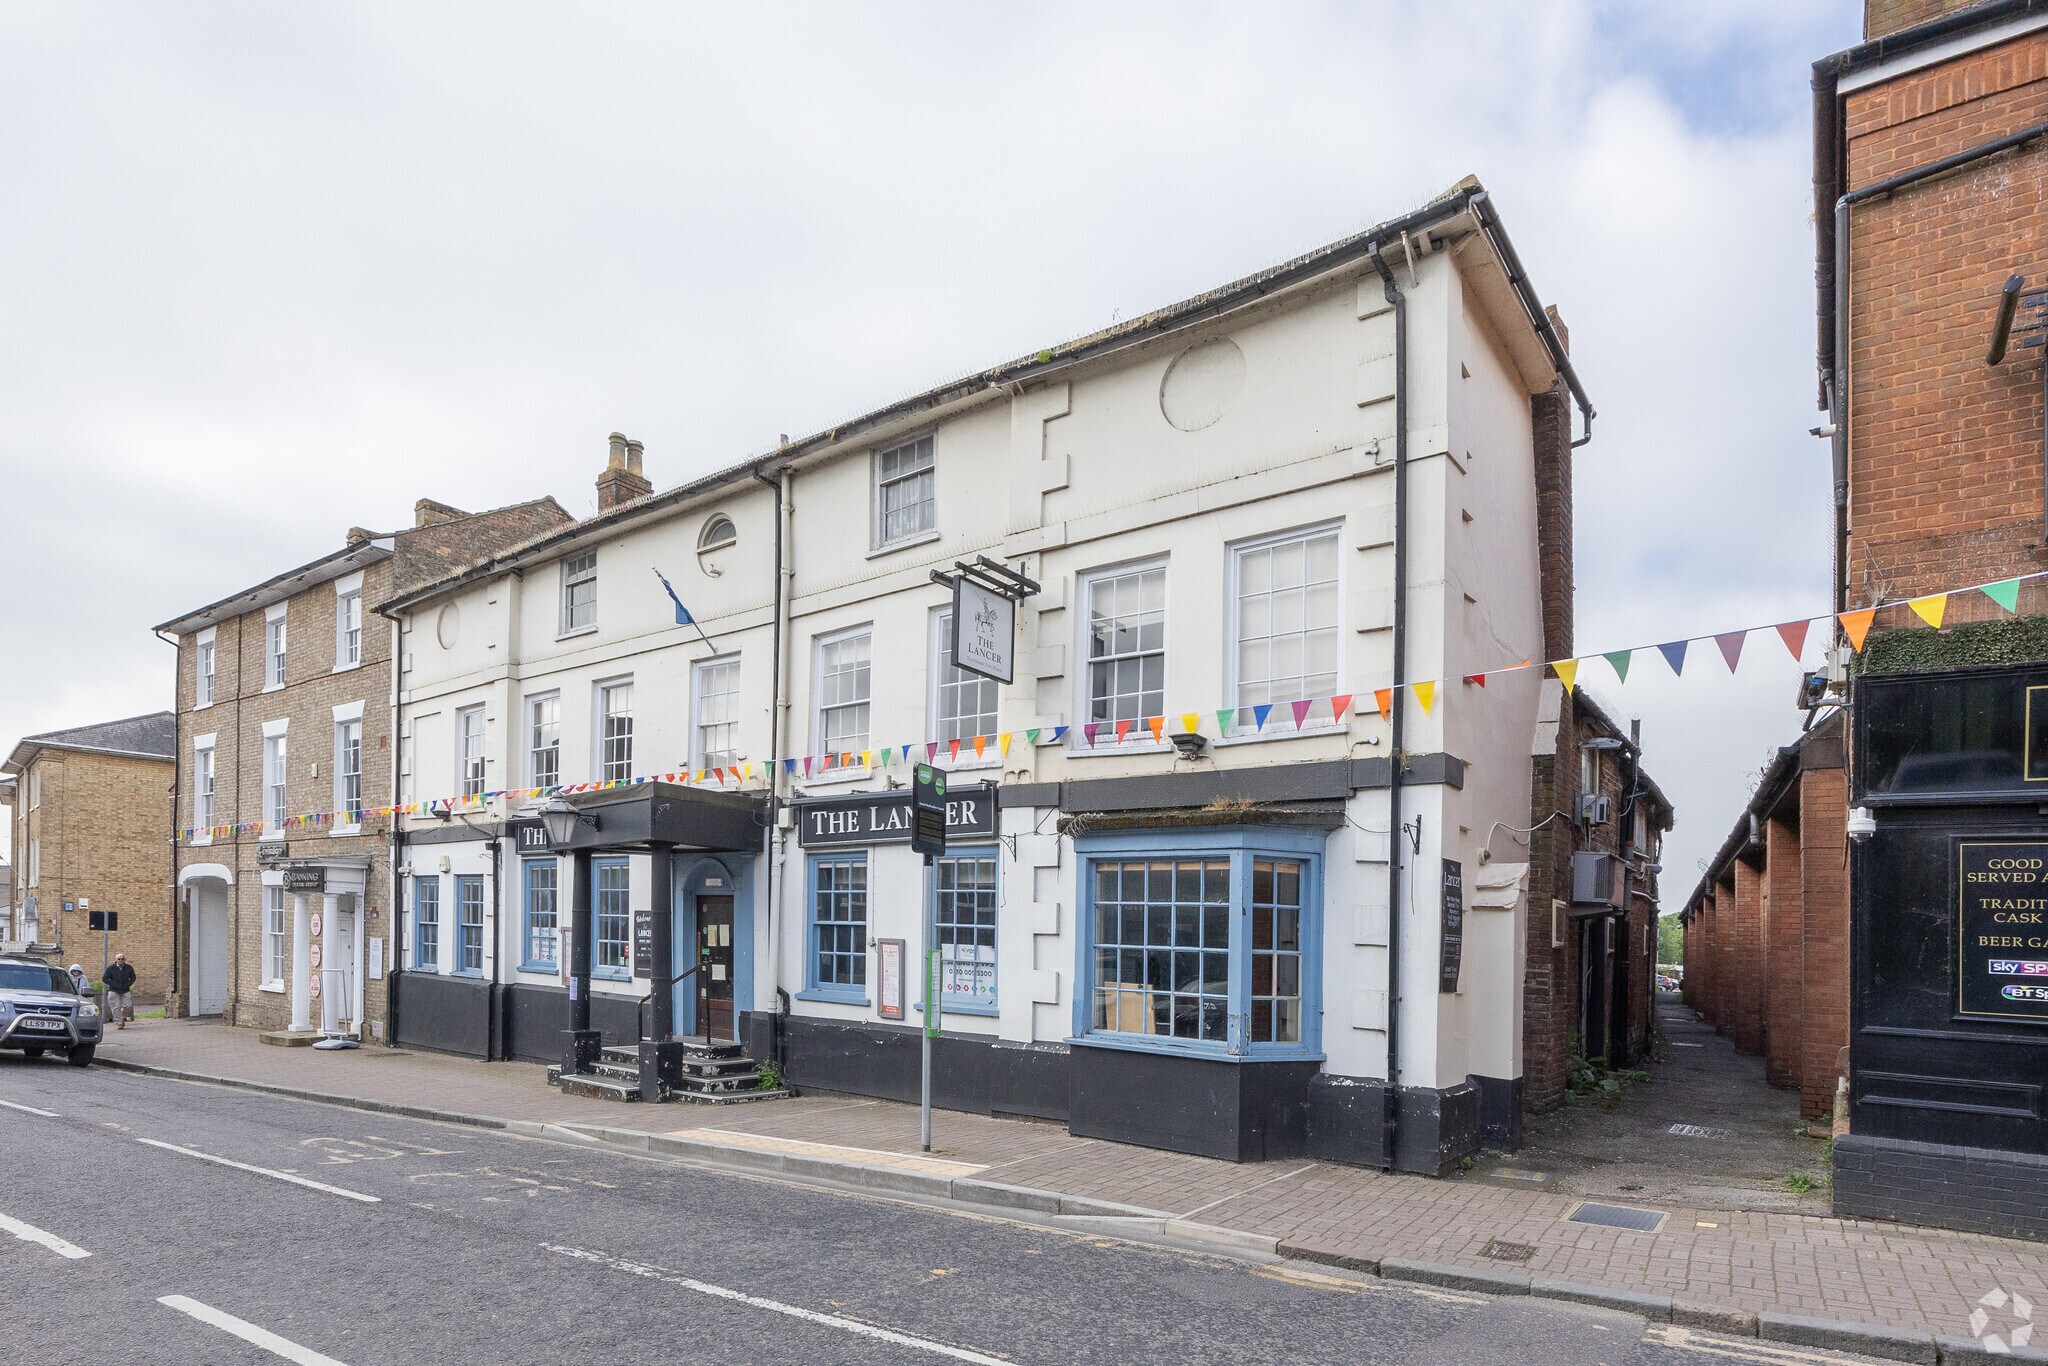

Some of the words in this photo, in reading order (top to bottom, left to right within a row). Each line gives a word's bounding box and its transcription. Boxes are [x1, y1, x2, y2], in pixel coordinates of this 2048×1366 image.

[977, 635, 994, 650] THE
[968, 643, 1002, 665] LANCER
[811, 809, 860, 835] THE
[870, 800, 978, 831] LANER
[523, 827, 547, 845] TH
[1988, 858, 2043, 870] GOOD
[291, 872, 319, 881] BANNING
[1967, 872, 2036, 883] SERVED
[1979, 898, 2048, 910] TRADIT
[1993, 912, 2043, 924] CASK
[1978, 936, 2023, 947] BEER
[1993, 961, 2019, 973] sky
[2024, 963, 2048, 973] SP
[2011, 988, 2034, 997] BT
